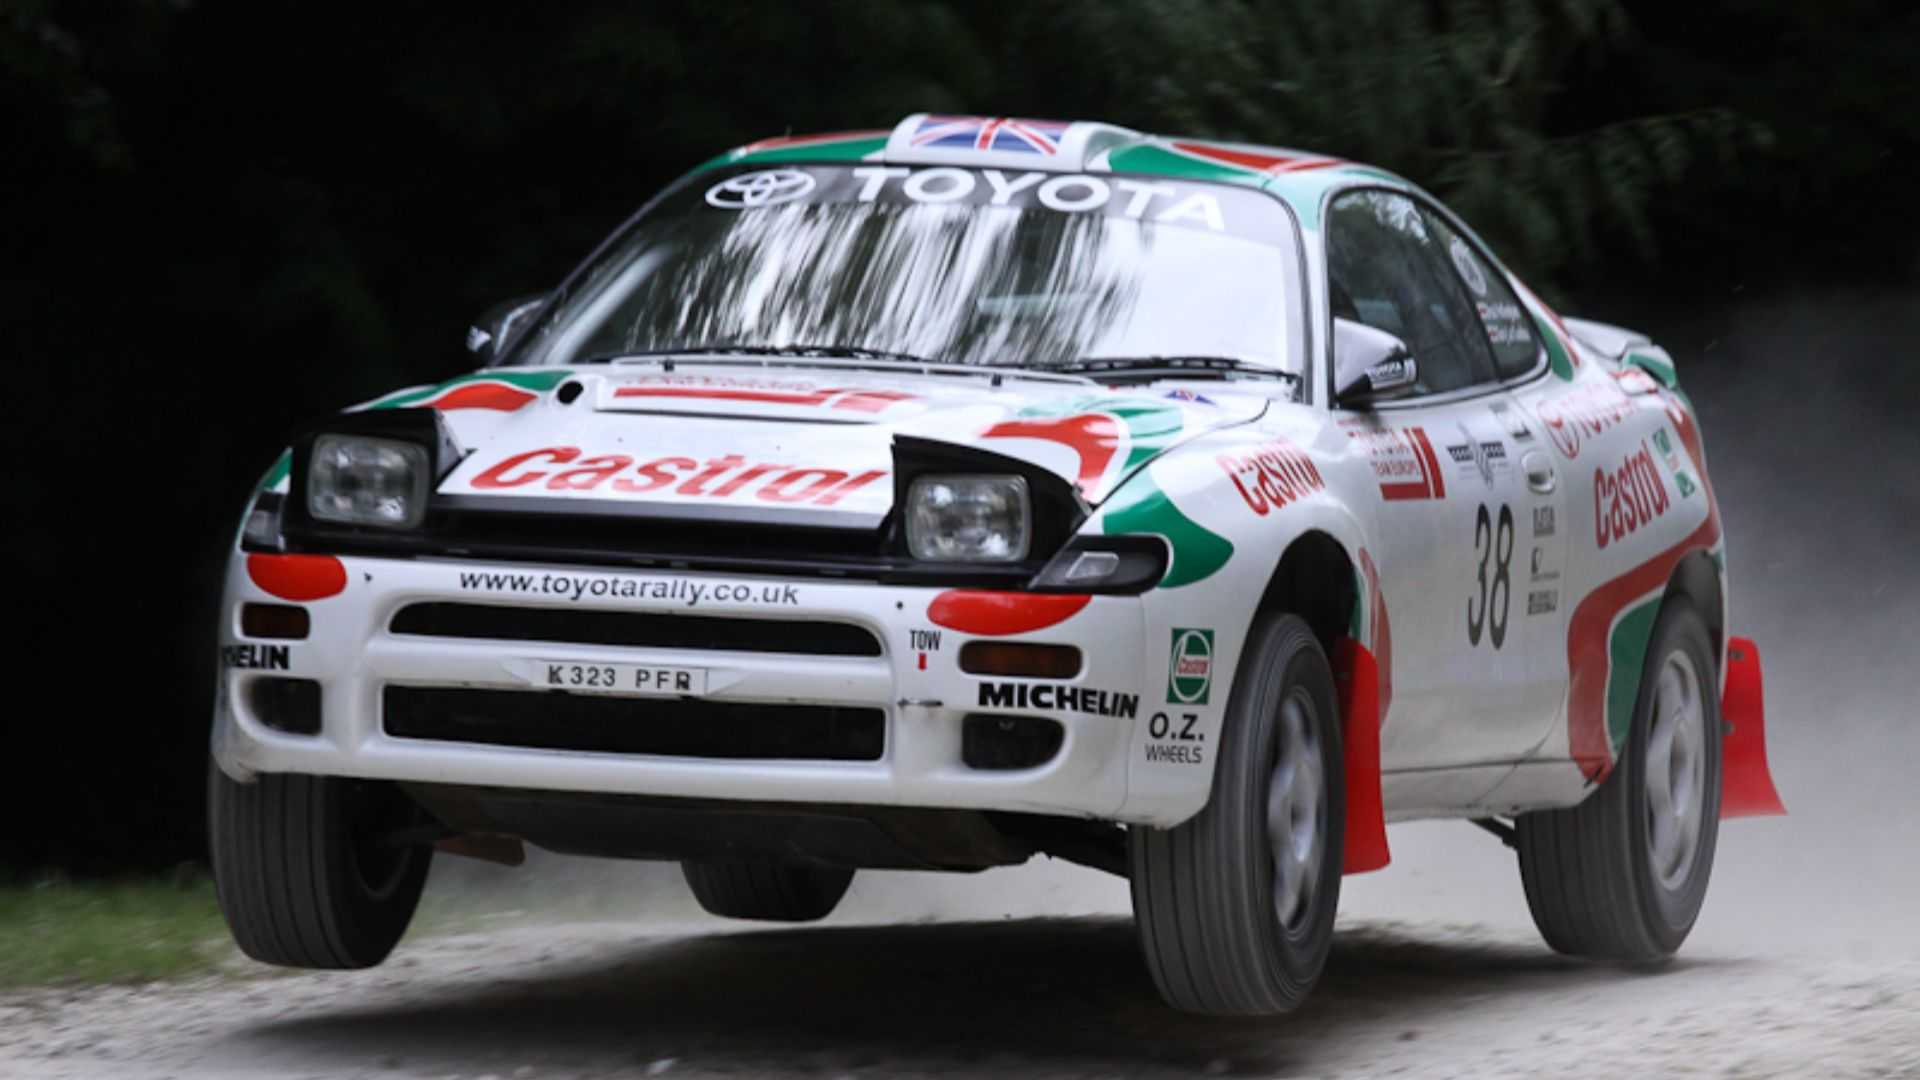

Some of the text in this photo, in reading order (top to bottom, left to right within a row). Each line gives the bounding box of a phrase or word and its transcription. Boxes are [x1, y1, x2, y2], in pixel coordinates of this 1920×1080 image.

[852, 167, 1227, 230] TOYOTA
[469, 446, 889, 506] Castrol
[1216, 440, 1326, 516] Castrol
[1594, 438, 1670, 550] Castrol
[459, 569, 799, 608] www.toyotarally.co.uk
[1468, 502, 1515, 650] 38
[910, 630, 942, 651] TOW
[548, 664, 692, 691] K323 PFR
[978, 682, 1140, 719] MICHELIN
[1149, 712, 1205, 742] O.Z.
[1145, 745, 1203, 764] WHEELS
